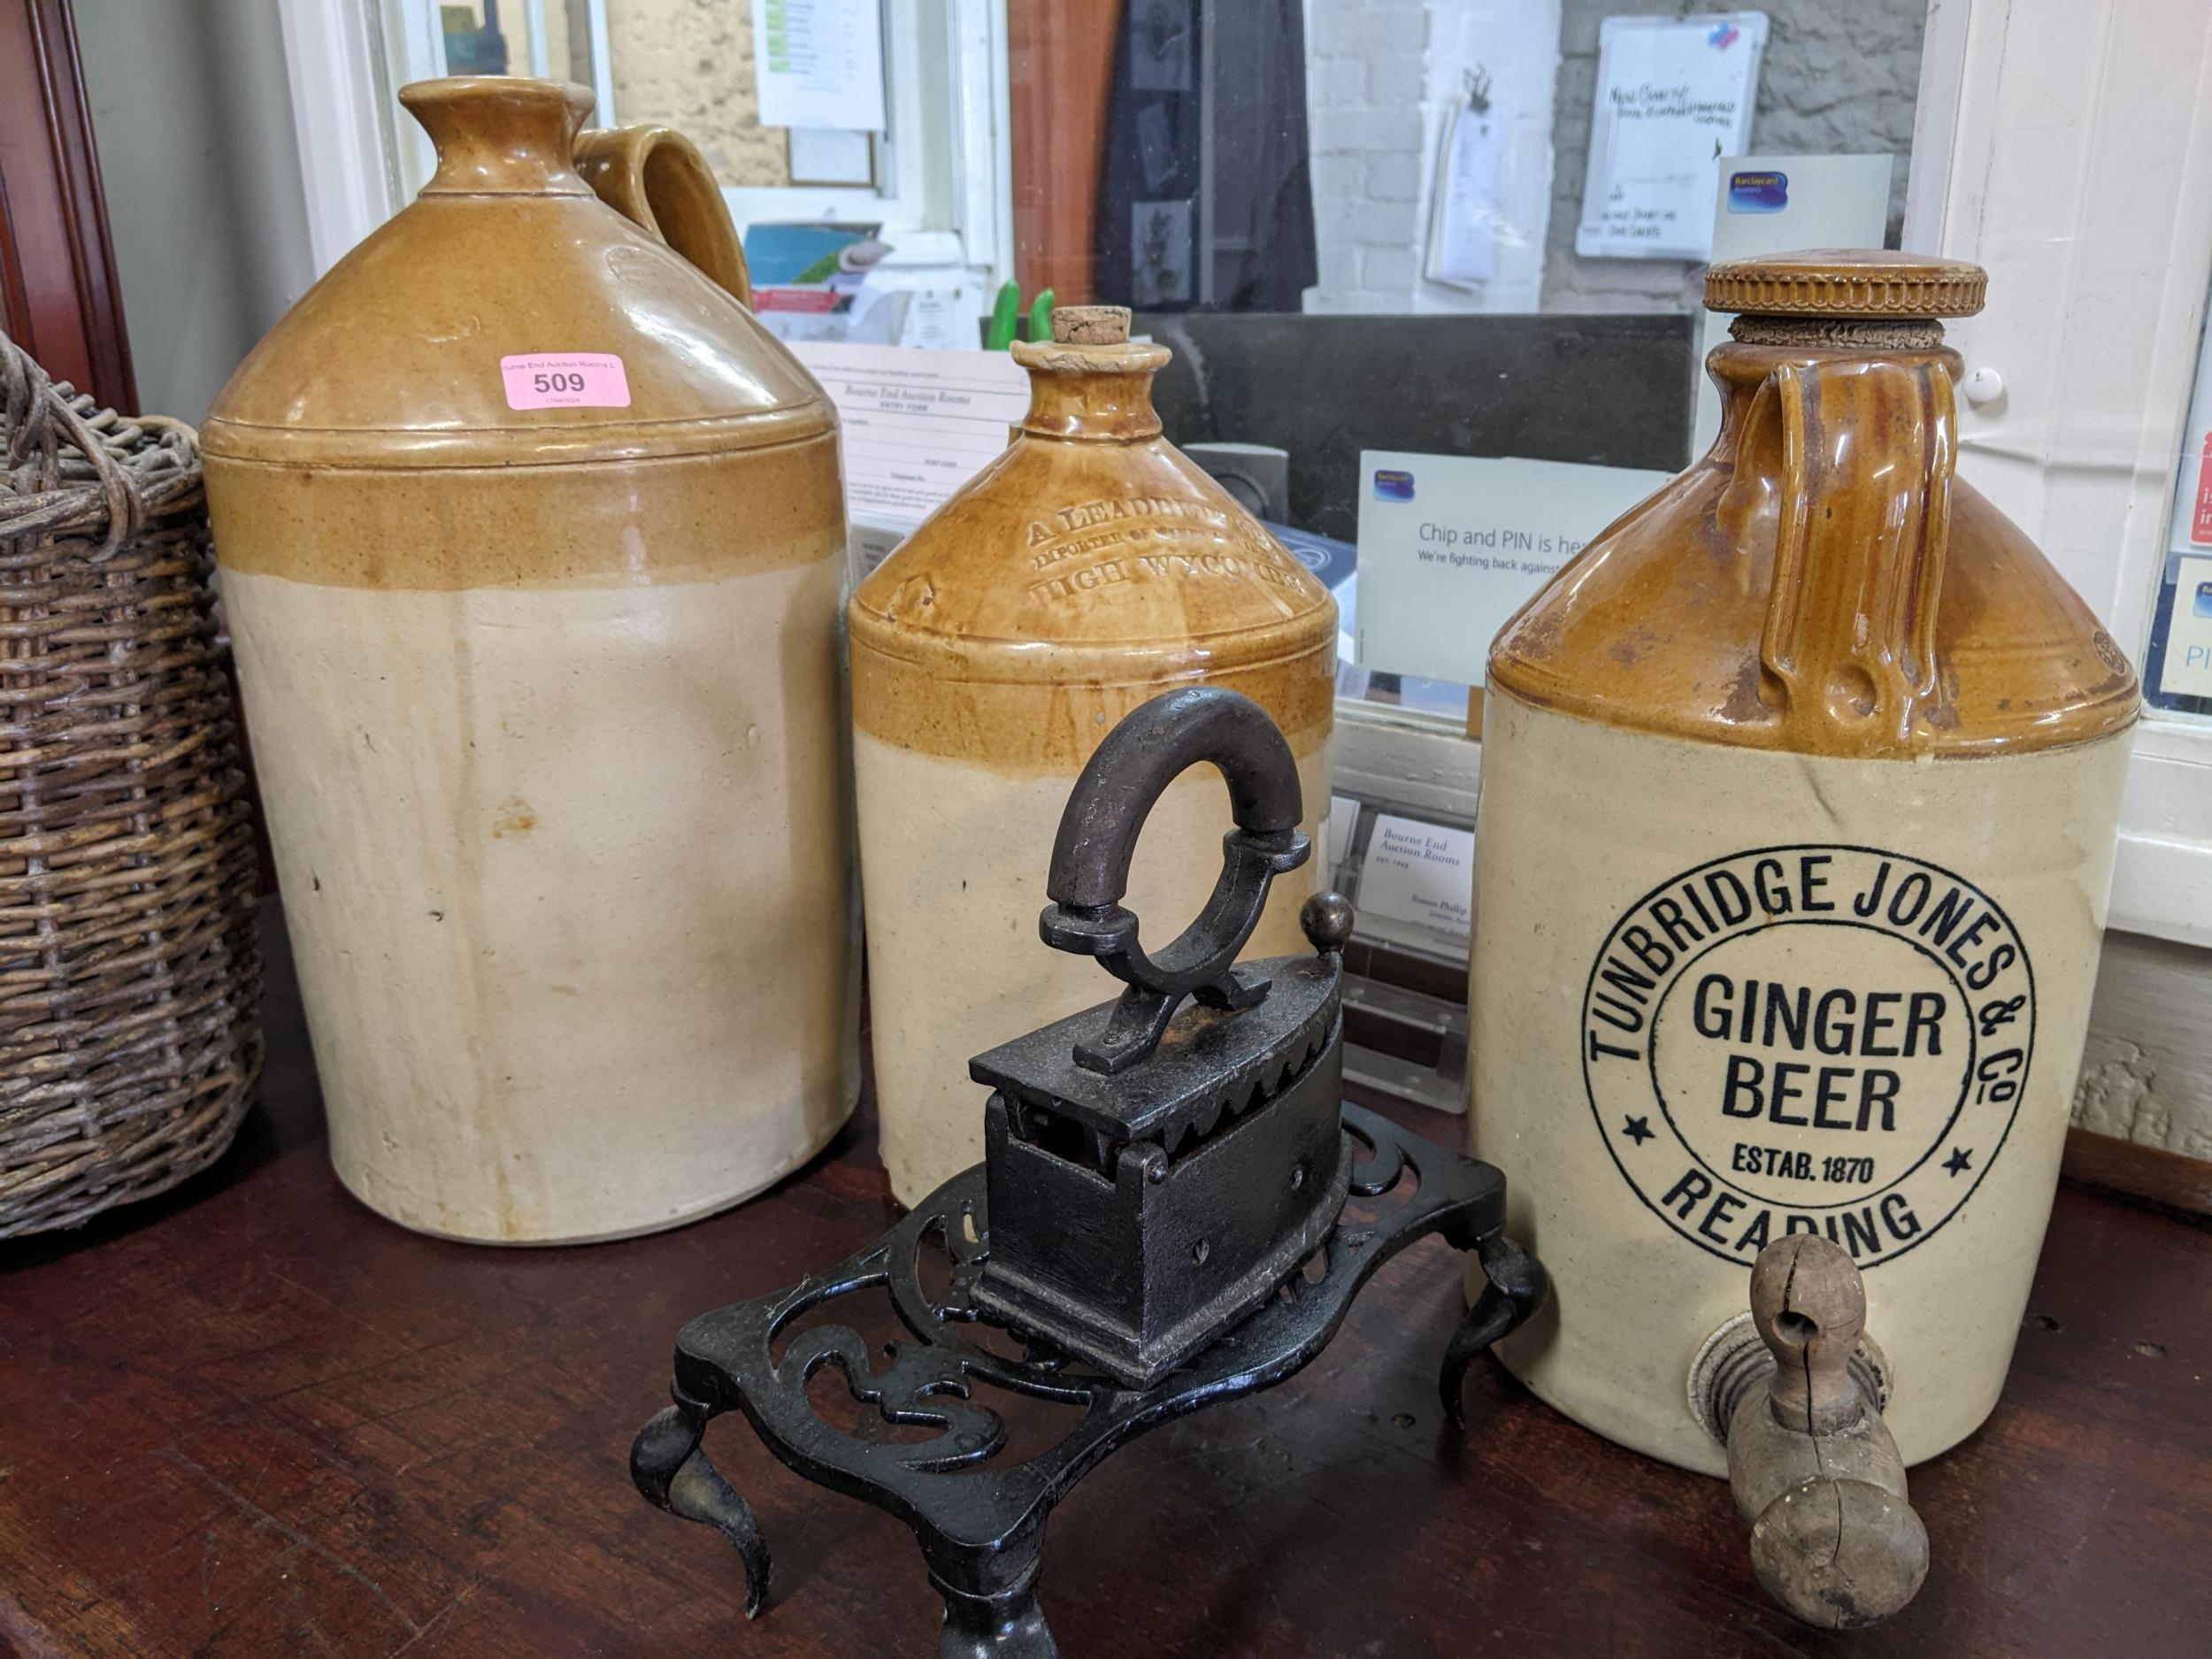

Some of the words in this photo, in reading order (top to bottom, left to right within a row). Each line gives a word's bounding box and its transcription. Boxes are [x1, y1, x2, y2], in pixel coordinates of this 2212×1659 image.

[534, 373, 585, 393] 509
[845, 385, 879, 398] Bourne
[879, 388, 899, 399] End
[901, 390, 936, 403] Auction
[938, 393, 972, 404] Rooms
[1419, 522, 1458, 547] Chip
[1463, 528, 1496, 548] and
[1502, 531, 1532, 550] PIN
[1539, 534, 1552, 553] is
[1558, 535, 1586, 555] he
[1417, 549, 1447, 564] We're
[1448, 551, 1490, 570] fighting
[1493, 557, 1517, 571] back
[1027, 558, 1131, 599] HIGH
[1380, 841, 1420, 857] Auction
[1424, 849, 1461, 866] Rooms
[1383, 828, 1422, 846] Bourne
[1425, 836, 1448, 851] End
[1591, 855, 1835, 1061] TUNBRIDGE
[1854, 862, 2016, 991] JONES
[1978, 994, 2026, 1036] &
[1693, 973, 1947, 1056] GINGER
[1722, 1055, 1901, 1132] BEER
[1732, 1143, 1816, 1181] ESTAB.
[1822, 1156, 1875, 1184] 1870
